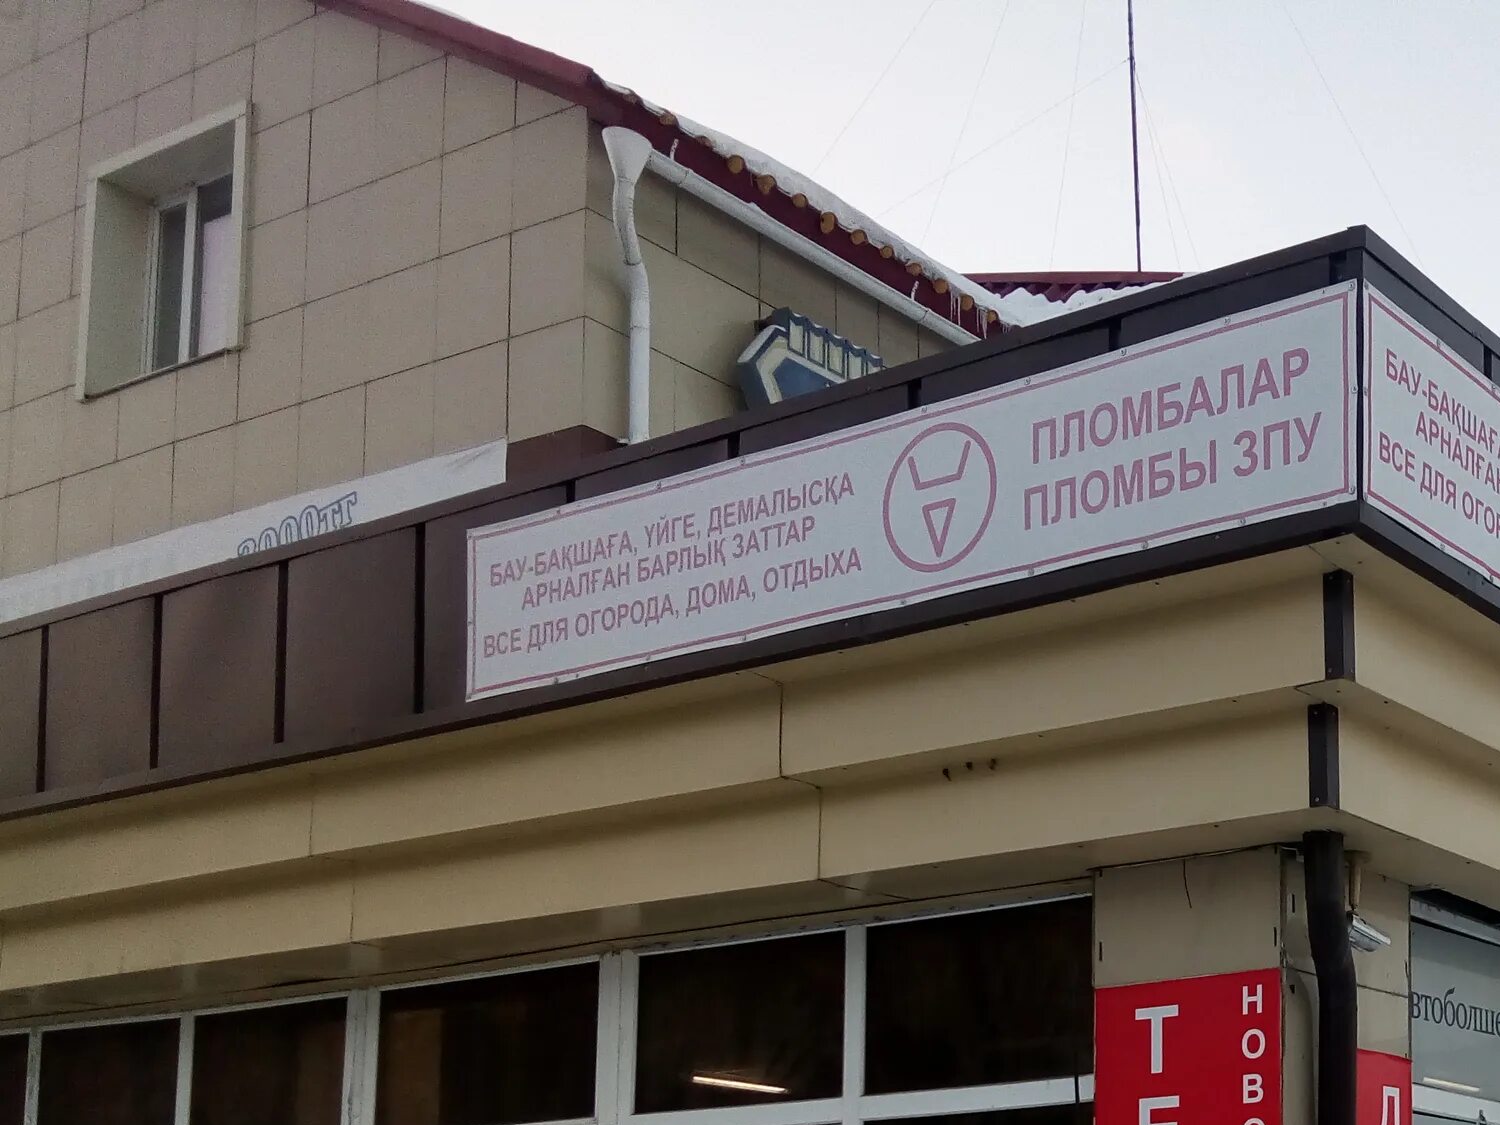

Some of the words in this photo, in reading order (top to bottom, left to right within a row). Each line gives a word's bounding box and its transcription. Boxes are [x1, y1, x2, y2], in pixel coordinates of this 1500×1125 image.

[1032, 347, 1310, 464] ПЛОМБАЛАР
[1023, 439, 1217, 530] ПЛОМБЫ
[1233, 411, 1322, 477] ЗПУ
[1379, 431, 1416, 482] ВСЕ
[1420, 461, 1457, 510] ДЛЯ
[489, 530, 638, 587] БАУ-БАҚШАҒА,
[644, 513, 701, 548] ҮЙГЕ,
[707, 471, 855, 537] ДЕМАЛЫСҚА
[521, 561, 630, 611] АРНАЛҒАН
[637, 537, 726, 582] БАРЛЫҚ
[732, 515, 816, 559] ЗАТТАР
[483, 628, 522, 658] ВСЕ
[527, 617, 569, 653] ДЛЯ
[575, 593, 680, 637] ОГОРОДА,
[686, 575, 756, 617] ДОМА,
[763, 547, 862, 593] ОТДЫХА
